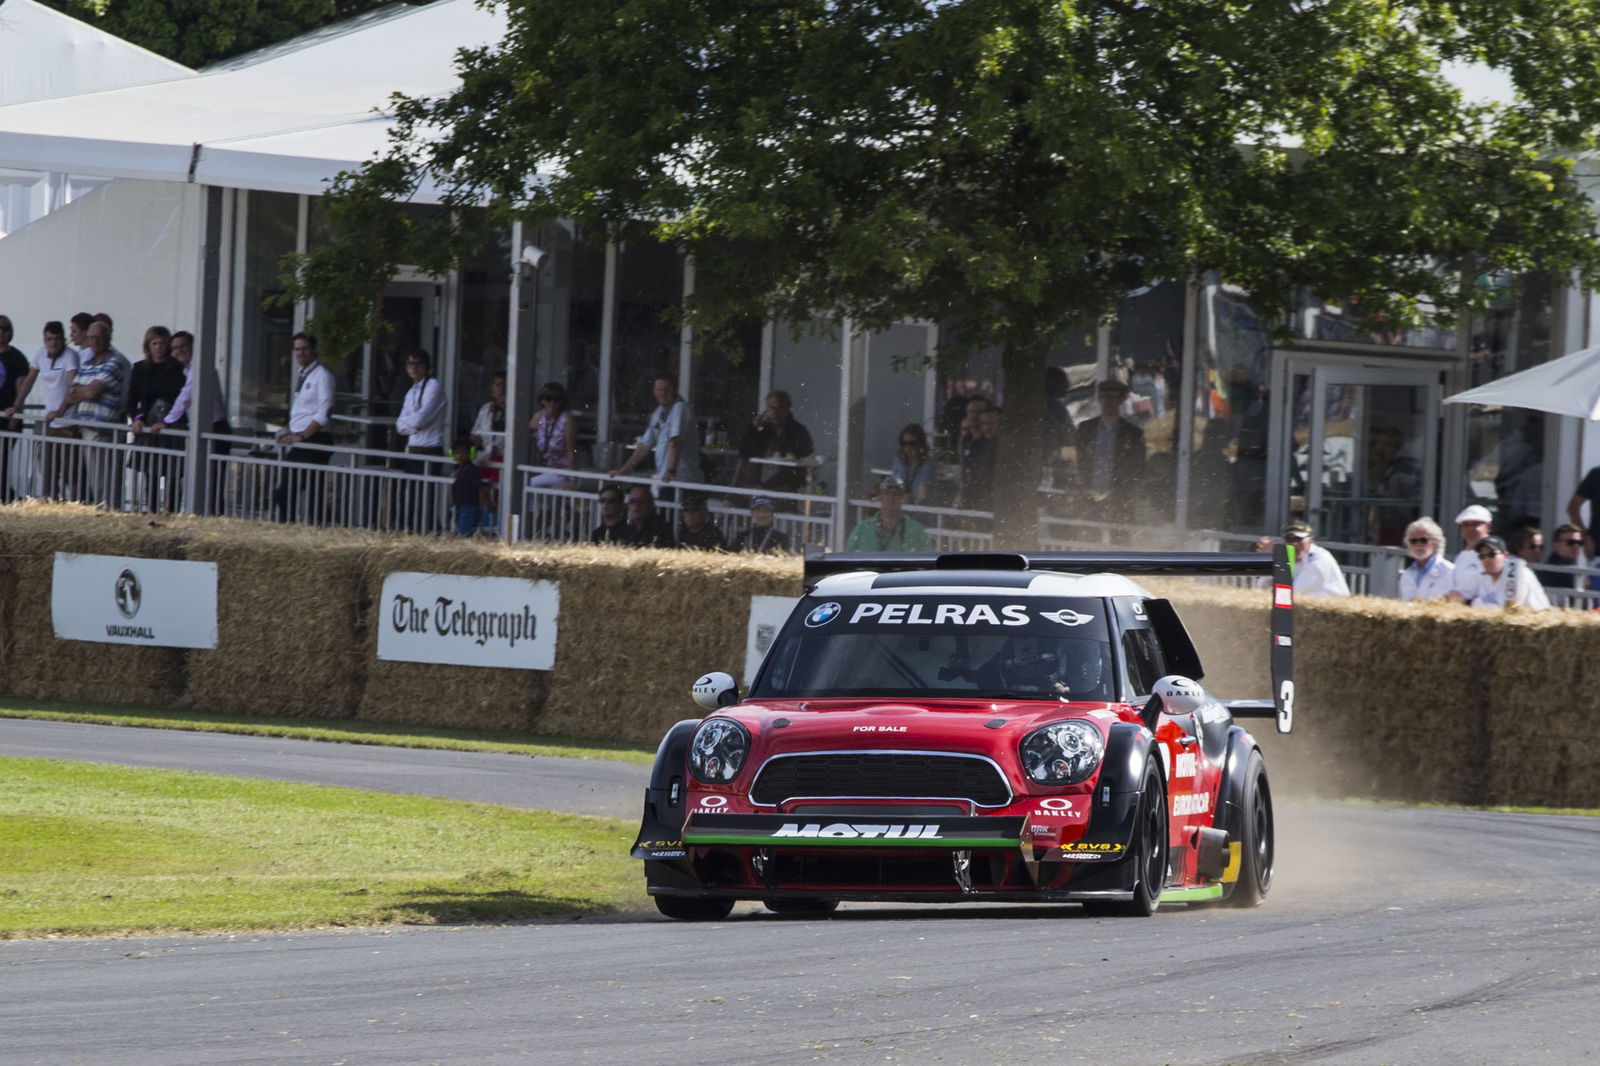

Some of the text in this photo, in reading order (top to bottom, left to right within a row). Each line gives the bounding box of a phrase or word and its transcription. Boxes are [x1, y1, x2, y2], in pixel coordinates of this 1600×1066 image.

[392, 594, 537, 648] The Telegraph
[849, 603, 1031, 626] PELRAS
[105, 624, 155, 639] VAUXHALL
[1279, 680, 1294, 732] 3
[1034, 810, 1081, 819] OAKLEY
[771, 823, 943, 838] MOTUL
